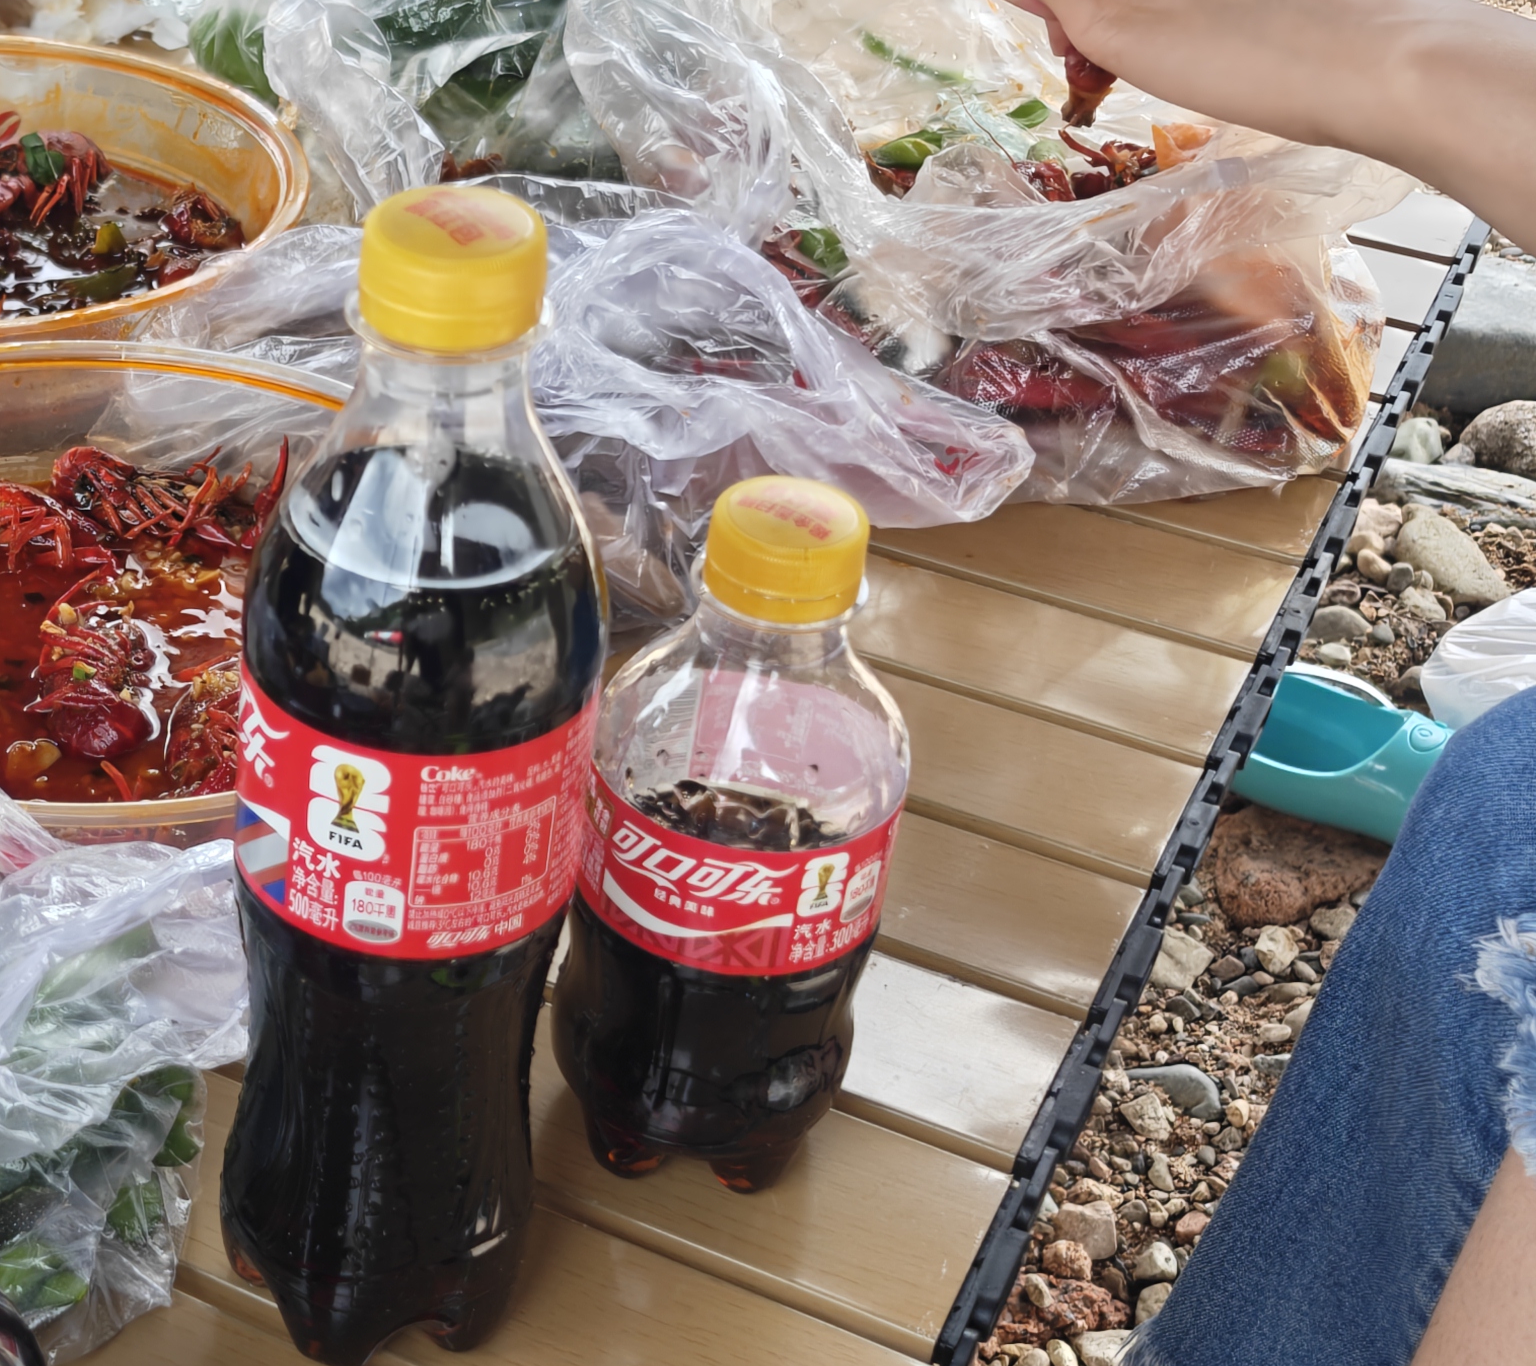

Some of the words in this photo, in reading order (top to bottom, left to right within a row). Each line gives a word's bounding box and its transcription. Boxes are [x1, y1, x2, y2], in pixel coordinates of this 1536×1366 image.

[420, 765, 476, 783] Coke
[328, 830, 363, 850] FIFA
[292, 836, 342, 880] 汽水
[611, 820, 799, 905] 可口可乐
[288, 887, 340, 932] 500毫升
[653, 887, 715, 918] 经典美味
[494, 914, 523, 936] 中国
[793, 918, 832, 941] 汽水
